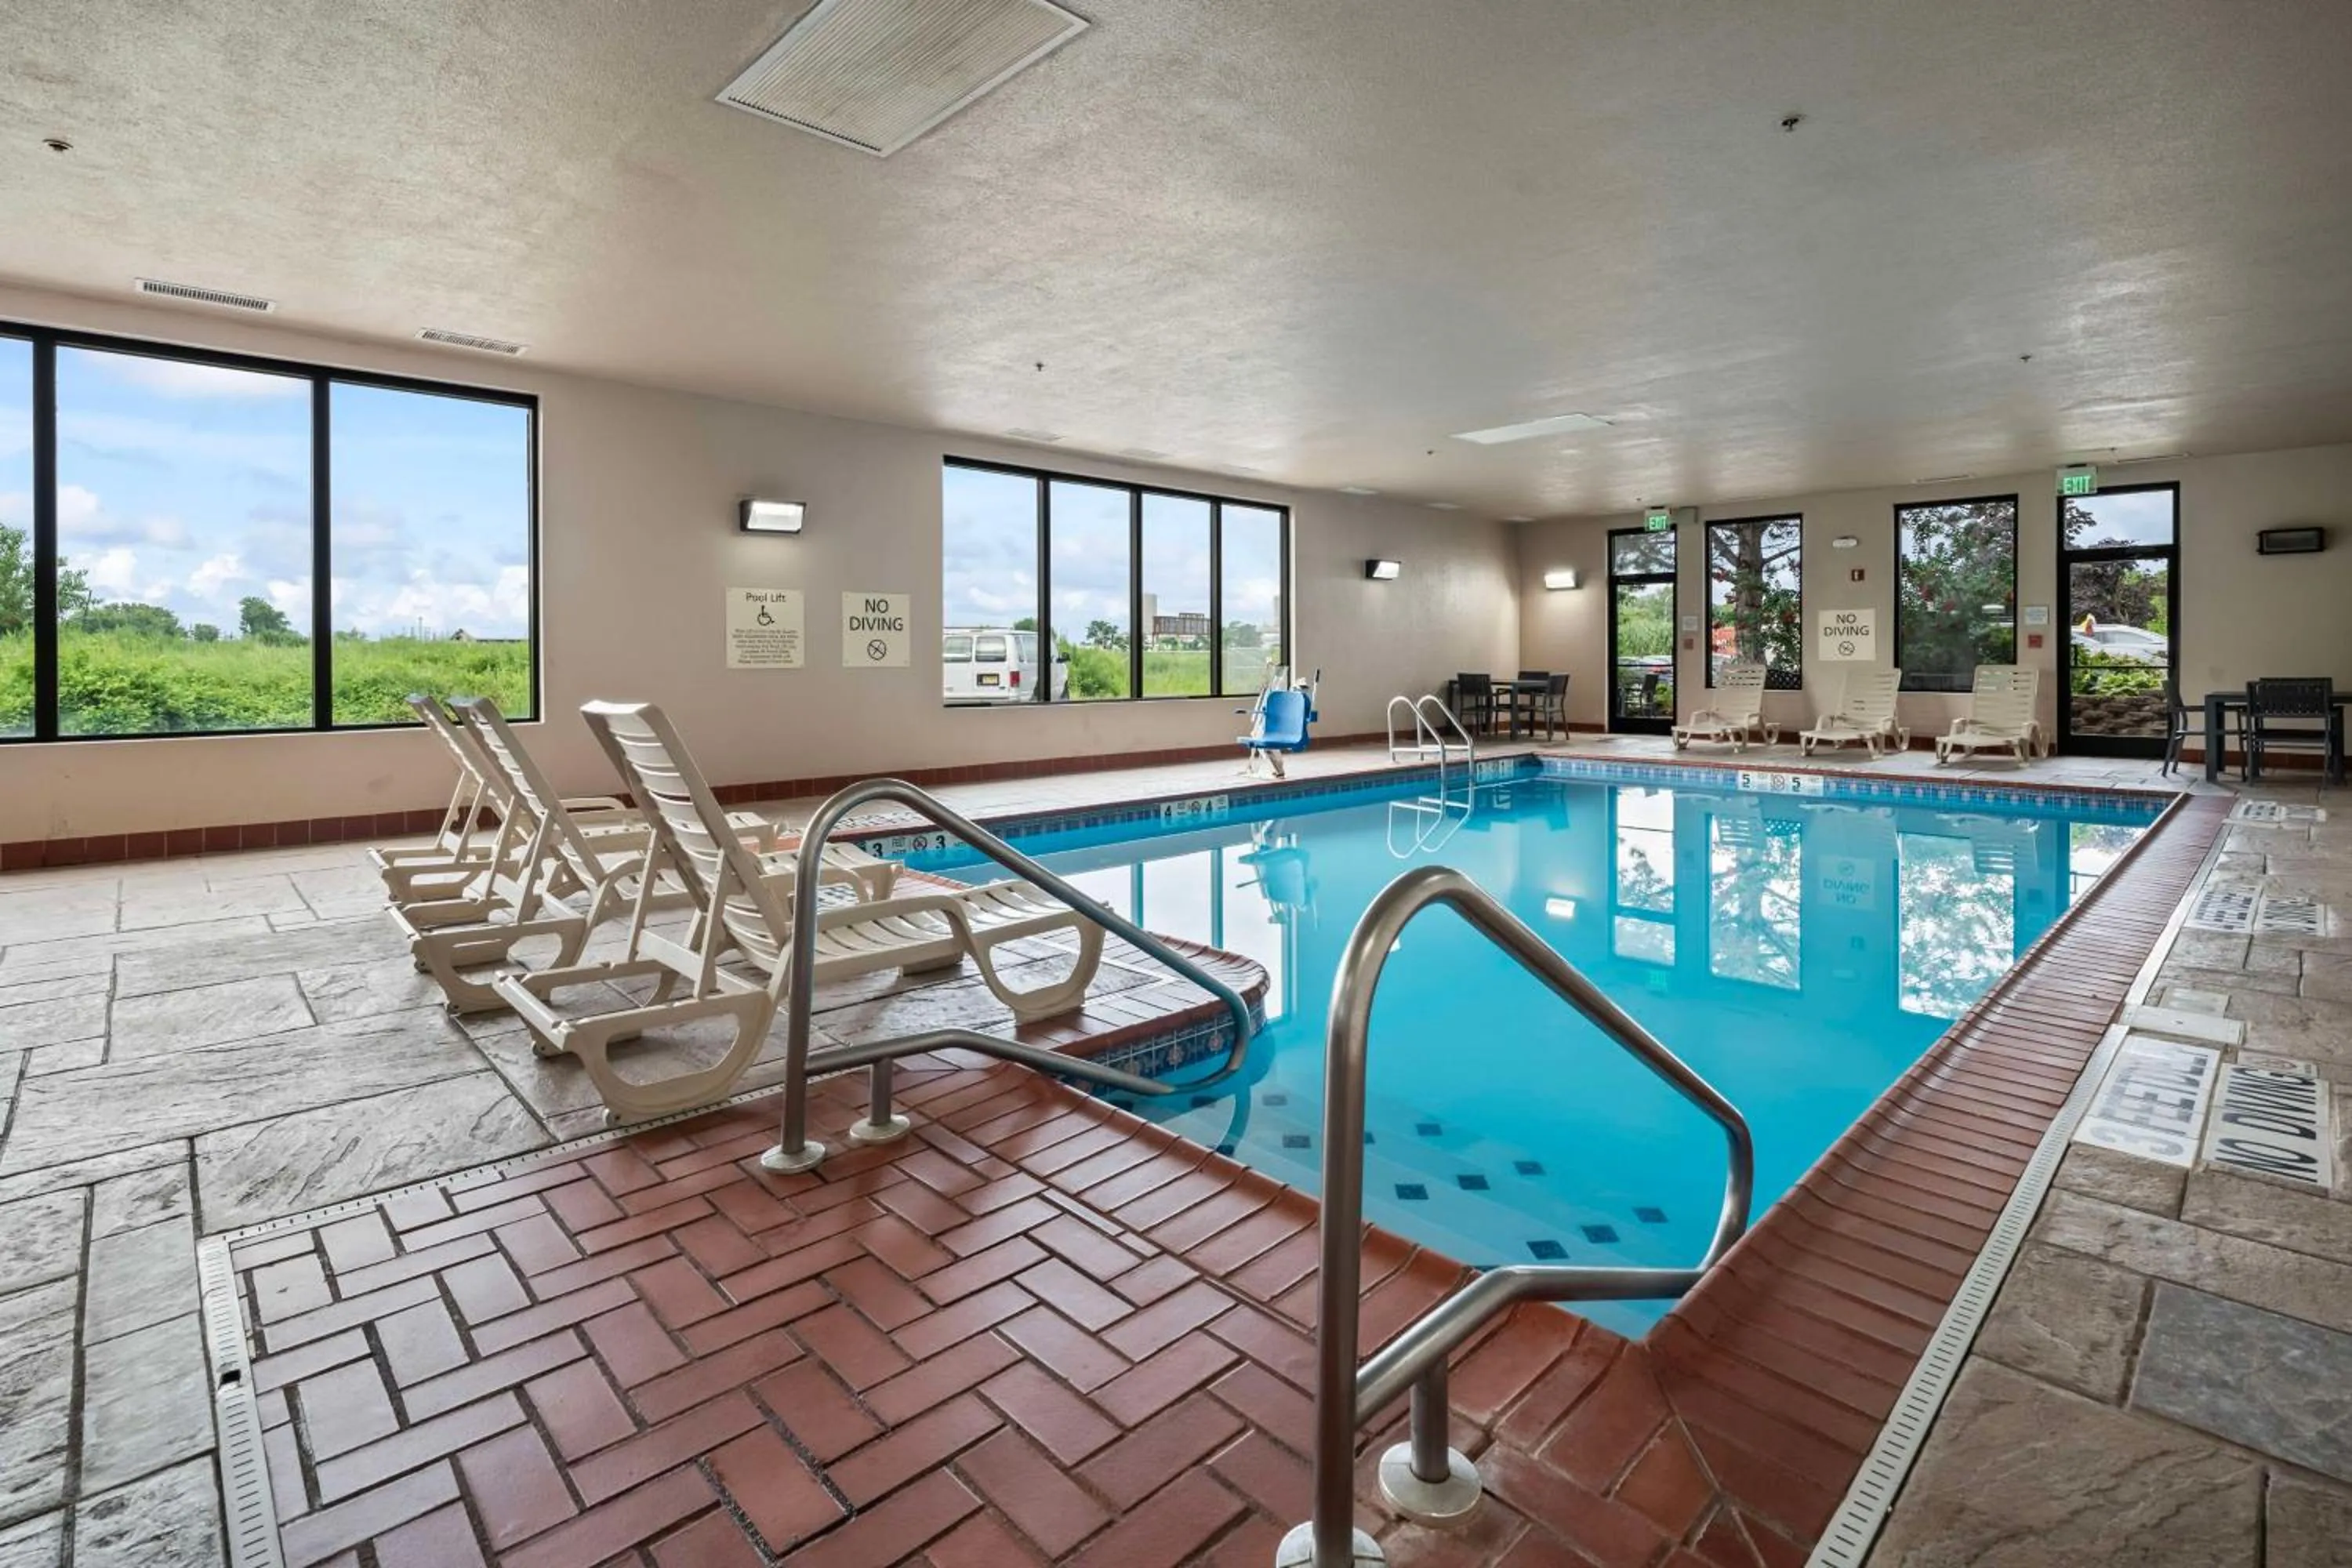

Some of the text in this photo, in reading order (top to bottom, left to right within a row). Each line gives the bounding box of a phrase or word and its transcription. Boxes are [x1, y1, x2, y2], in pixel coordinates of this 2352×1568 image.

[2063, 476, 2090, 494] EXIT
[1649, 516, 1668, 531] EXIT
[746, 592, 786, 603] Pool Lift
[865, 598, 889, 614] NO
[849, 615, 904, 631] DIVING
[1836, 613, 1857, 624] NO
[1824, 625, 1870, 637] DIVING
[935, 834, 946, 849] 3
[872, 842, 883, 858] 3
[2098, 1073, 2198, 1137] FEET
[2216, 1067, 2318, 1183] NO DIVING
